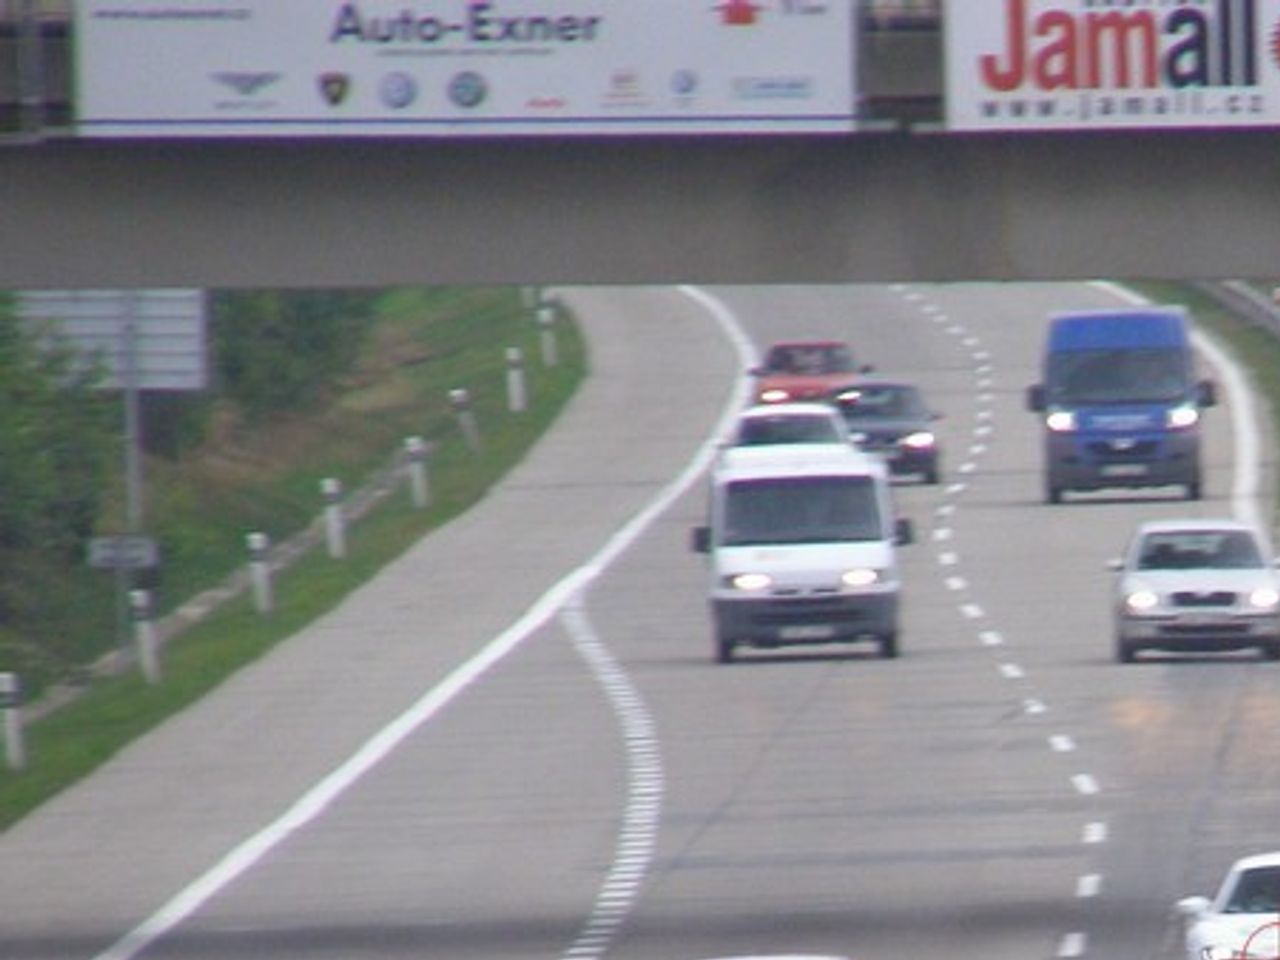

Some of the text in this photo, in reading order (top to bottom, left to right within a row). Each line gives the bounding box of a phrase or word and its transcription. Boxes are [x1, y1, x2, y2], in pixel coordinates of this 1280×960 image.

[329, 2, 600, 42] Auto-Exner
[980, 0, 1259, 91] Jamall
[981, 96, 1264, 120] www.jamall.cz
